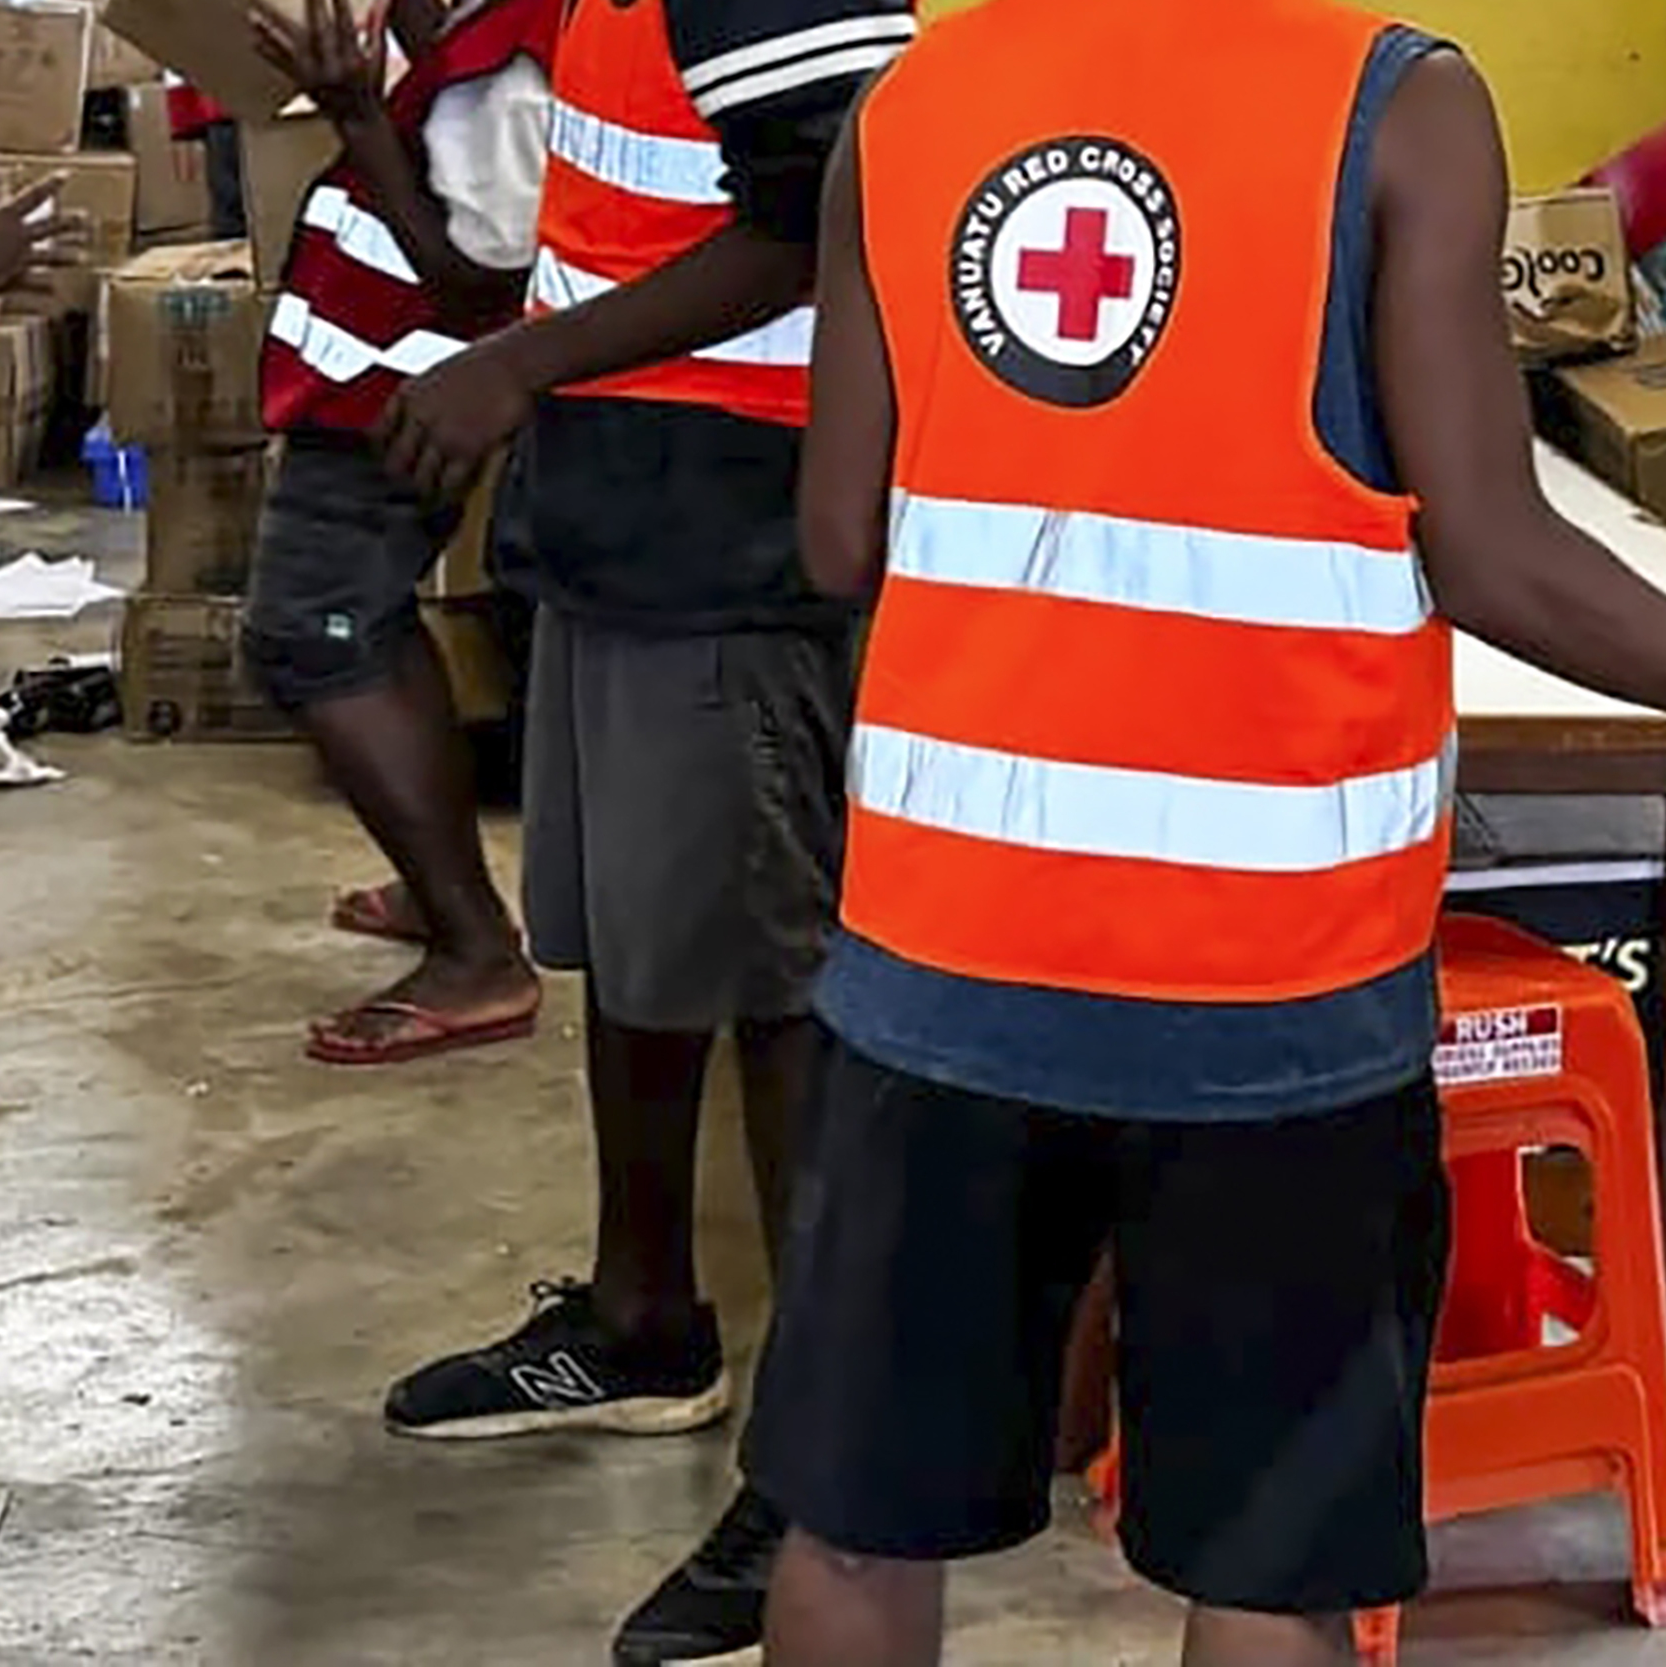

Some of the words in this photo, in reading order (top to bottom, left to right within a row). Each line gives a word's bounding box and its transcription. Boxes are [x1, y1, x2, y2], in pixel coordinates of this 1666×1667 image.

[1001, 148, 1068, 196] RED
[1079, 145, 1167, 213] CROSS
[1455, 1006, 1528, 1044] RUSH
